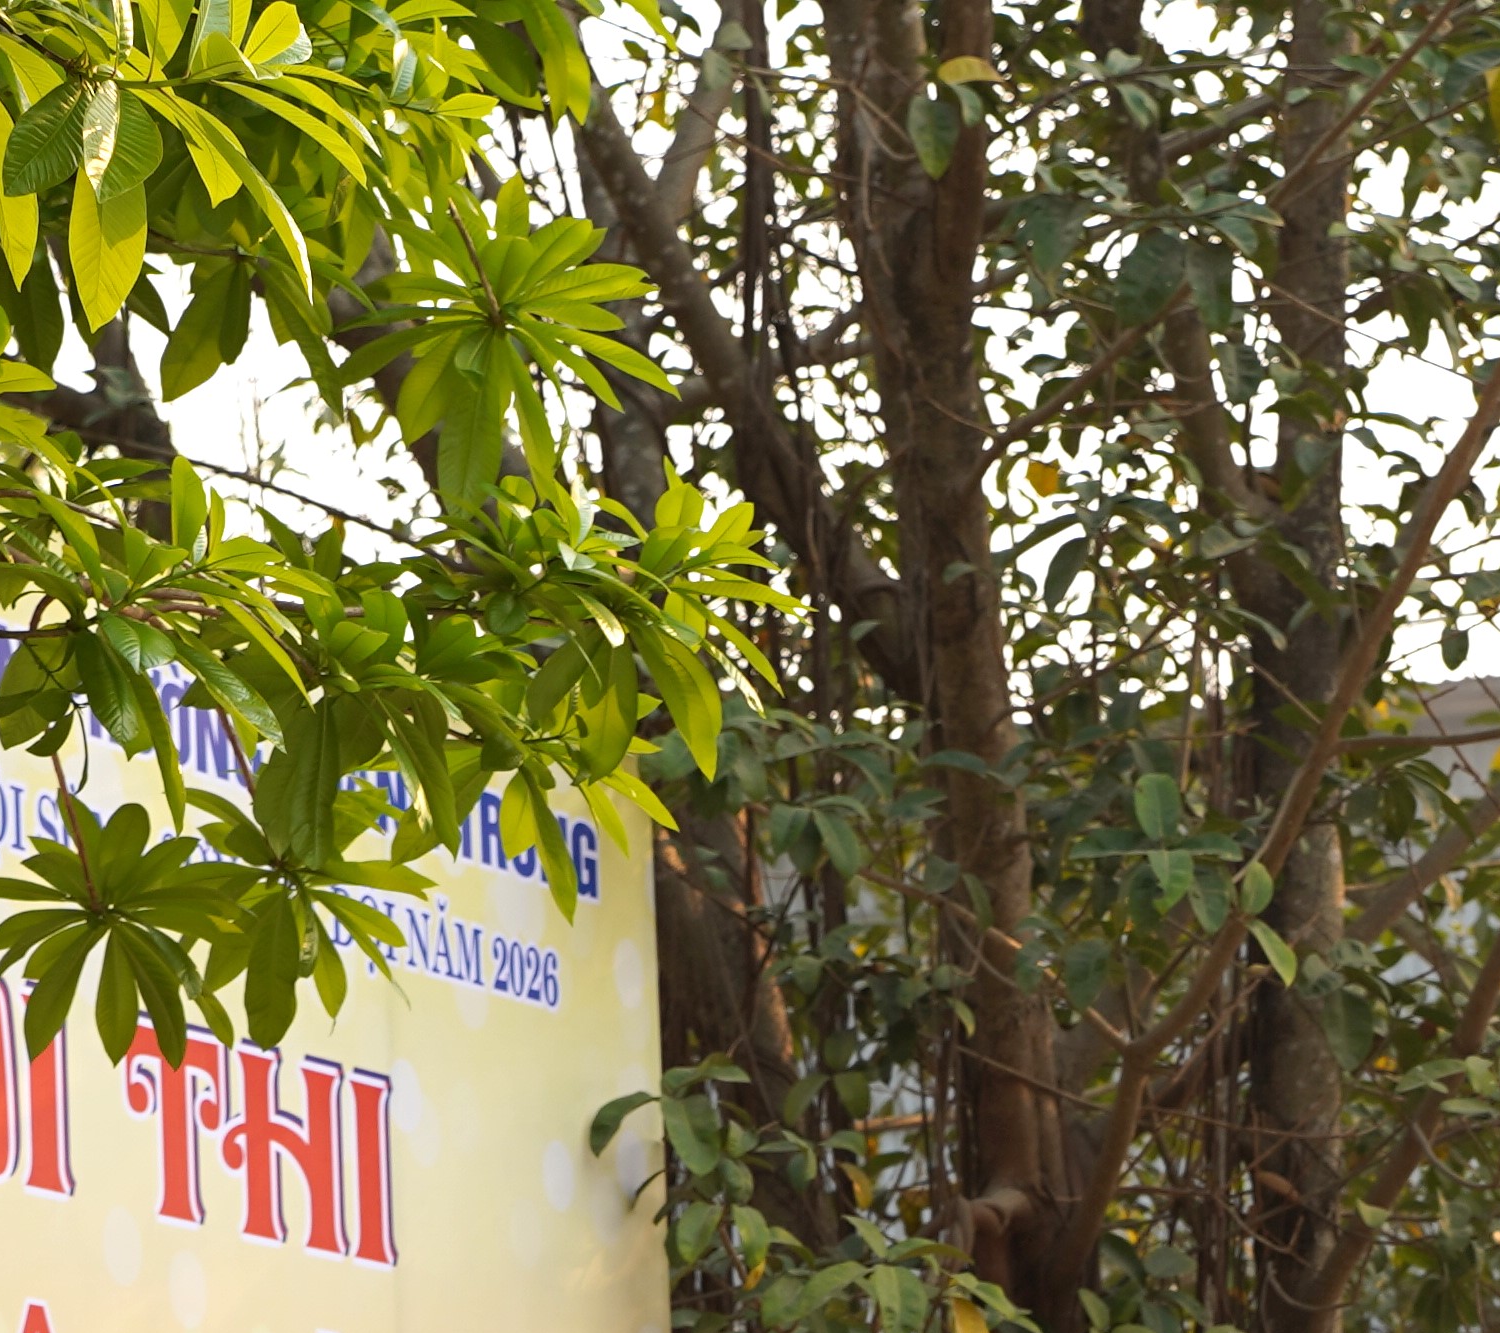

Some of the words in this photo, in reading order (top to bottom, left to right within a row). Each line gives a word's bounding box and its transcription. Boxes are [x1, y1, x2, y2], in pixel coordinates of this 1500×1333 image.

[406, 898, 485, 987] NĂM
[493, 936, 560, 1007] 2026
[125, 1010, 398, 1267] THI
